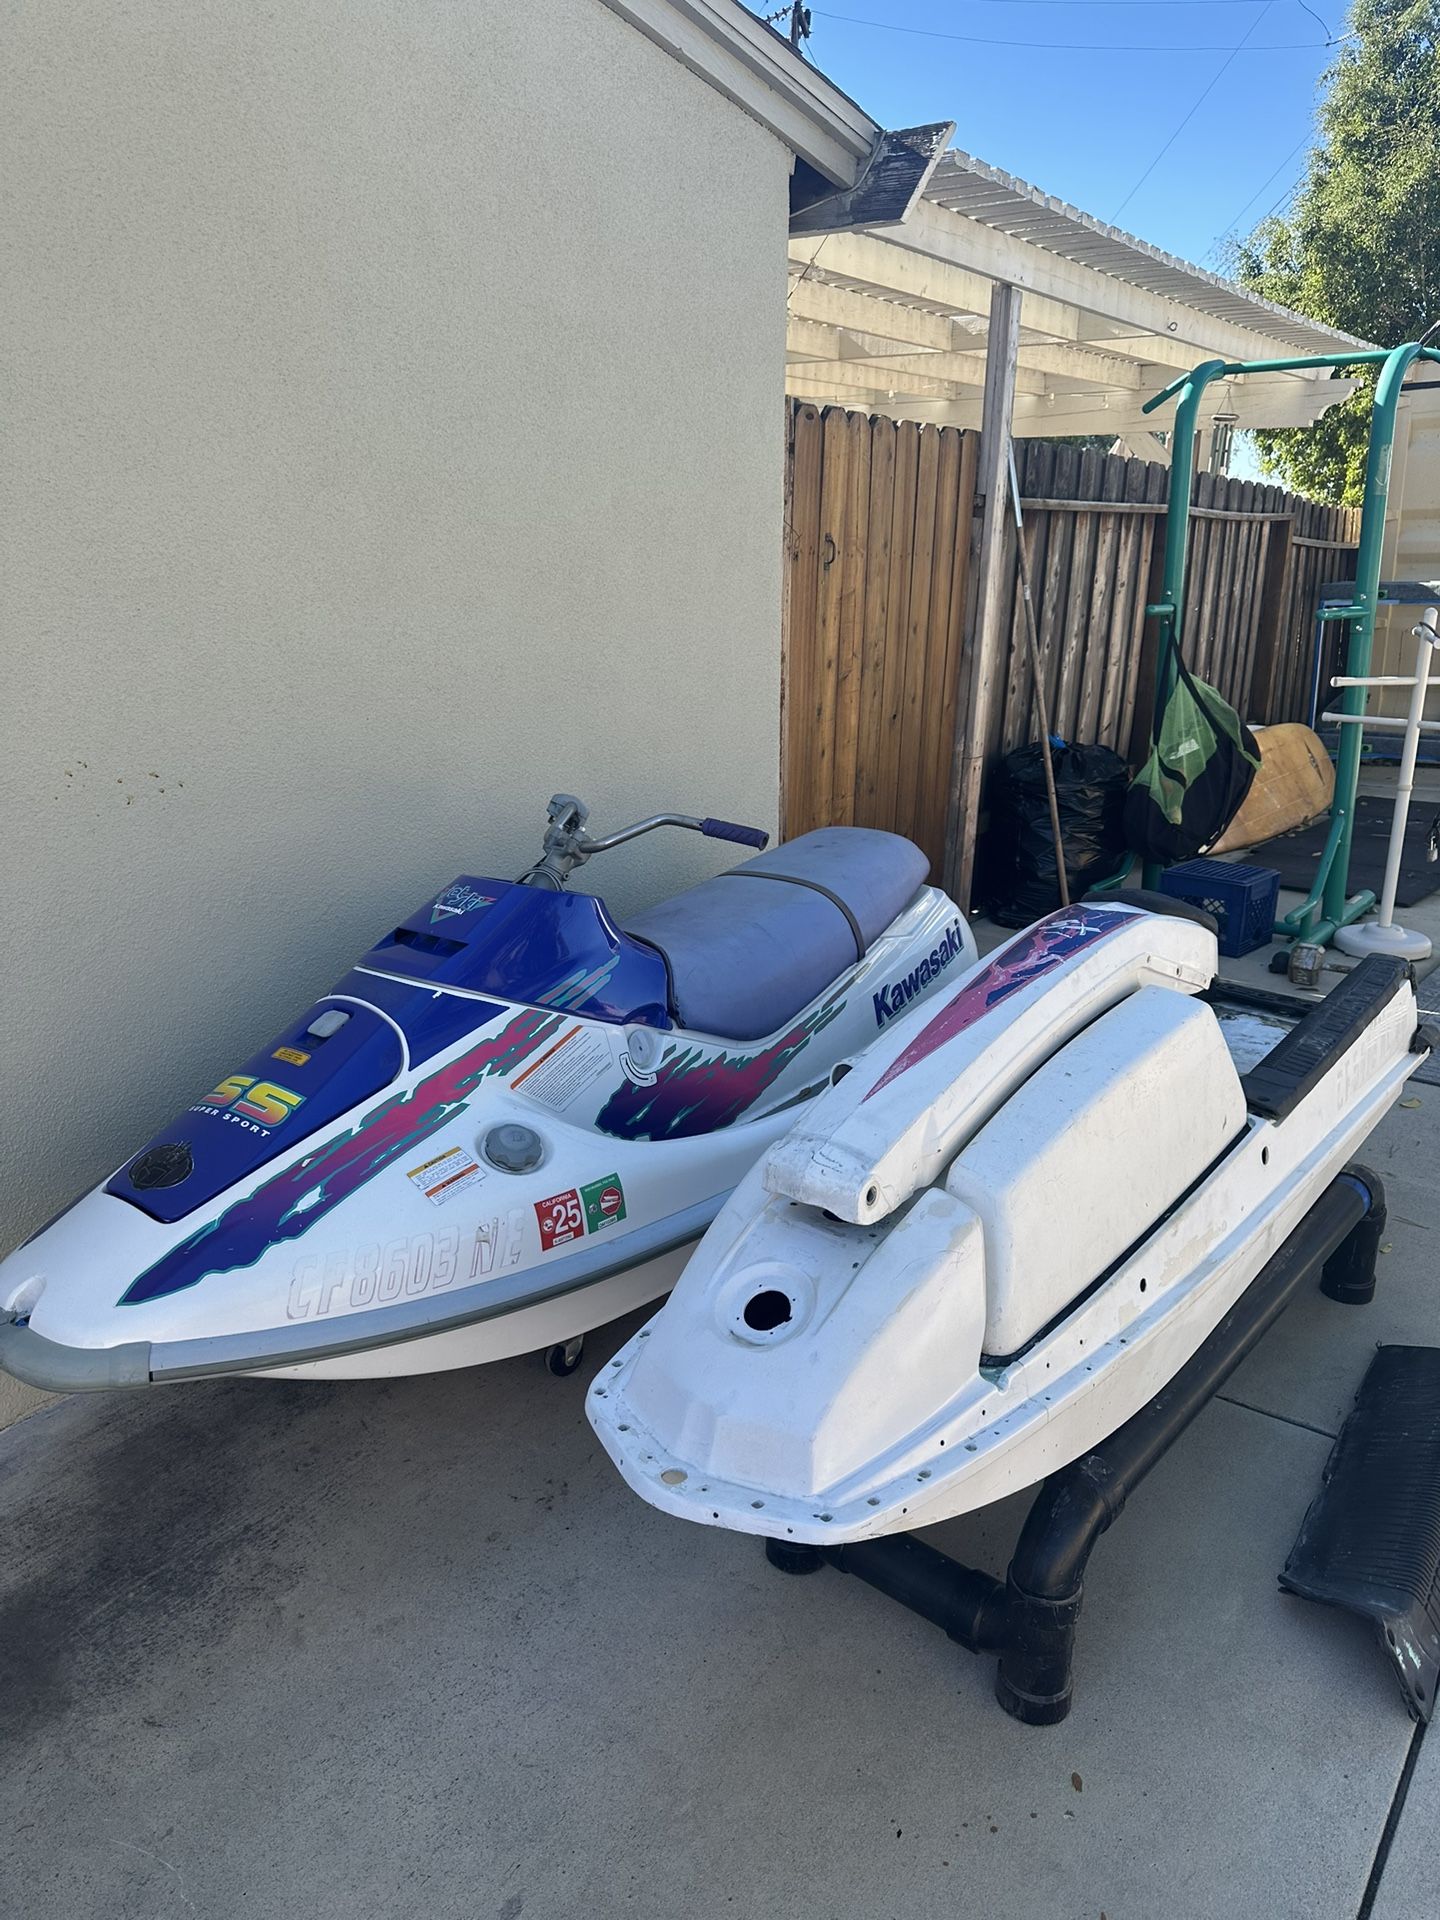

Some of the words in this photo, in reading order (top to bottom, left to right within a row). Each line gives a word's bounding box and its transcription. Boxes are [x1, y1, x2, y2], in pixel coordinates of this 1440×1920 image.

[872, 918, 964, 1030] Kawasaki
[200, 1074, 306, 1128] SS
[188, 1105, 220, 1117] SUPER
[222, 1113, 271, 1137] SPORT
[542, 1193, 572, 1208] CALIFORNIA
[552, 1199, 582, 1235] 25
